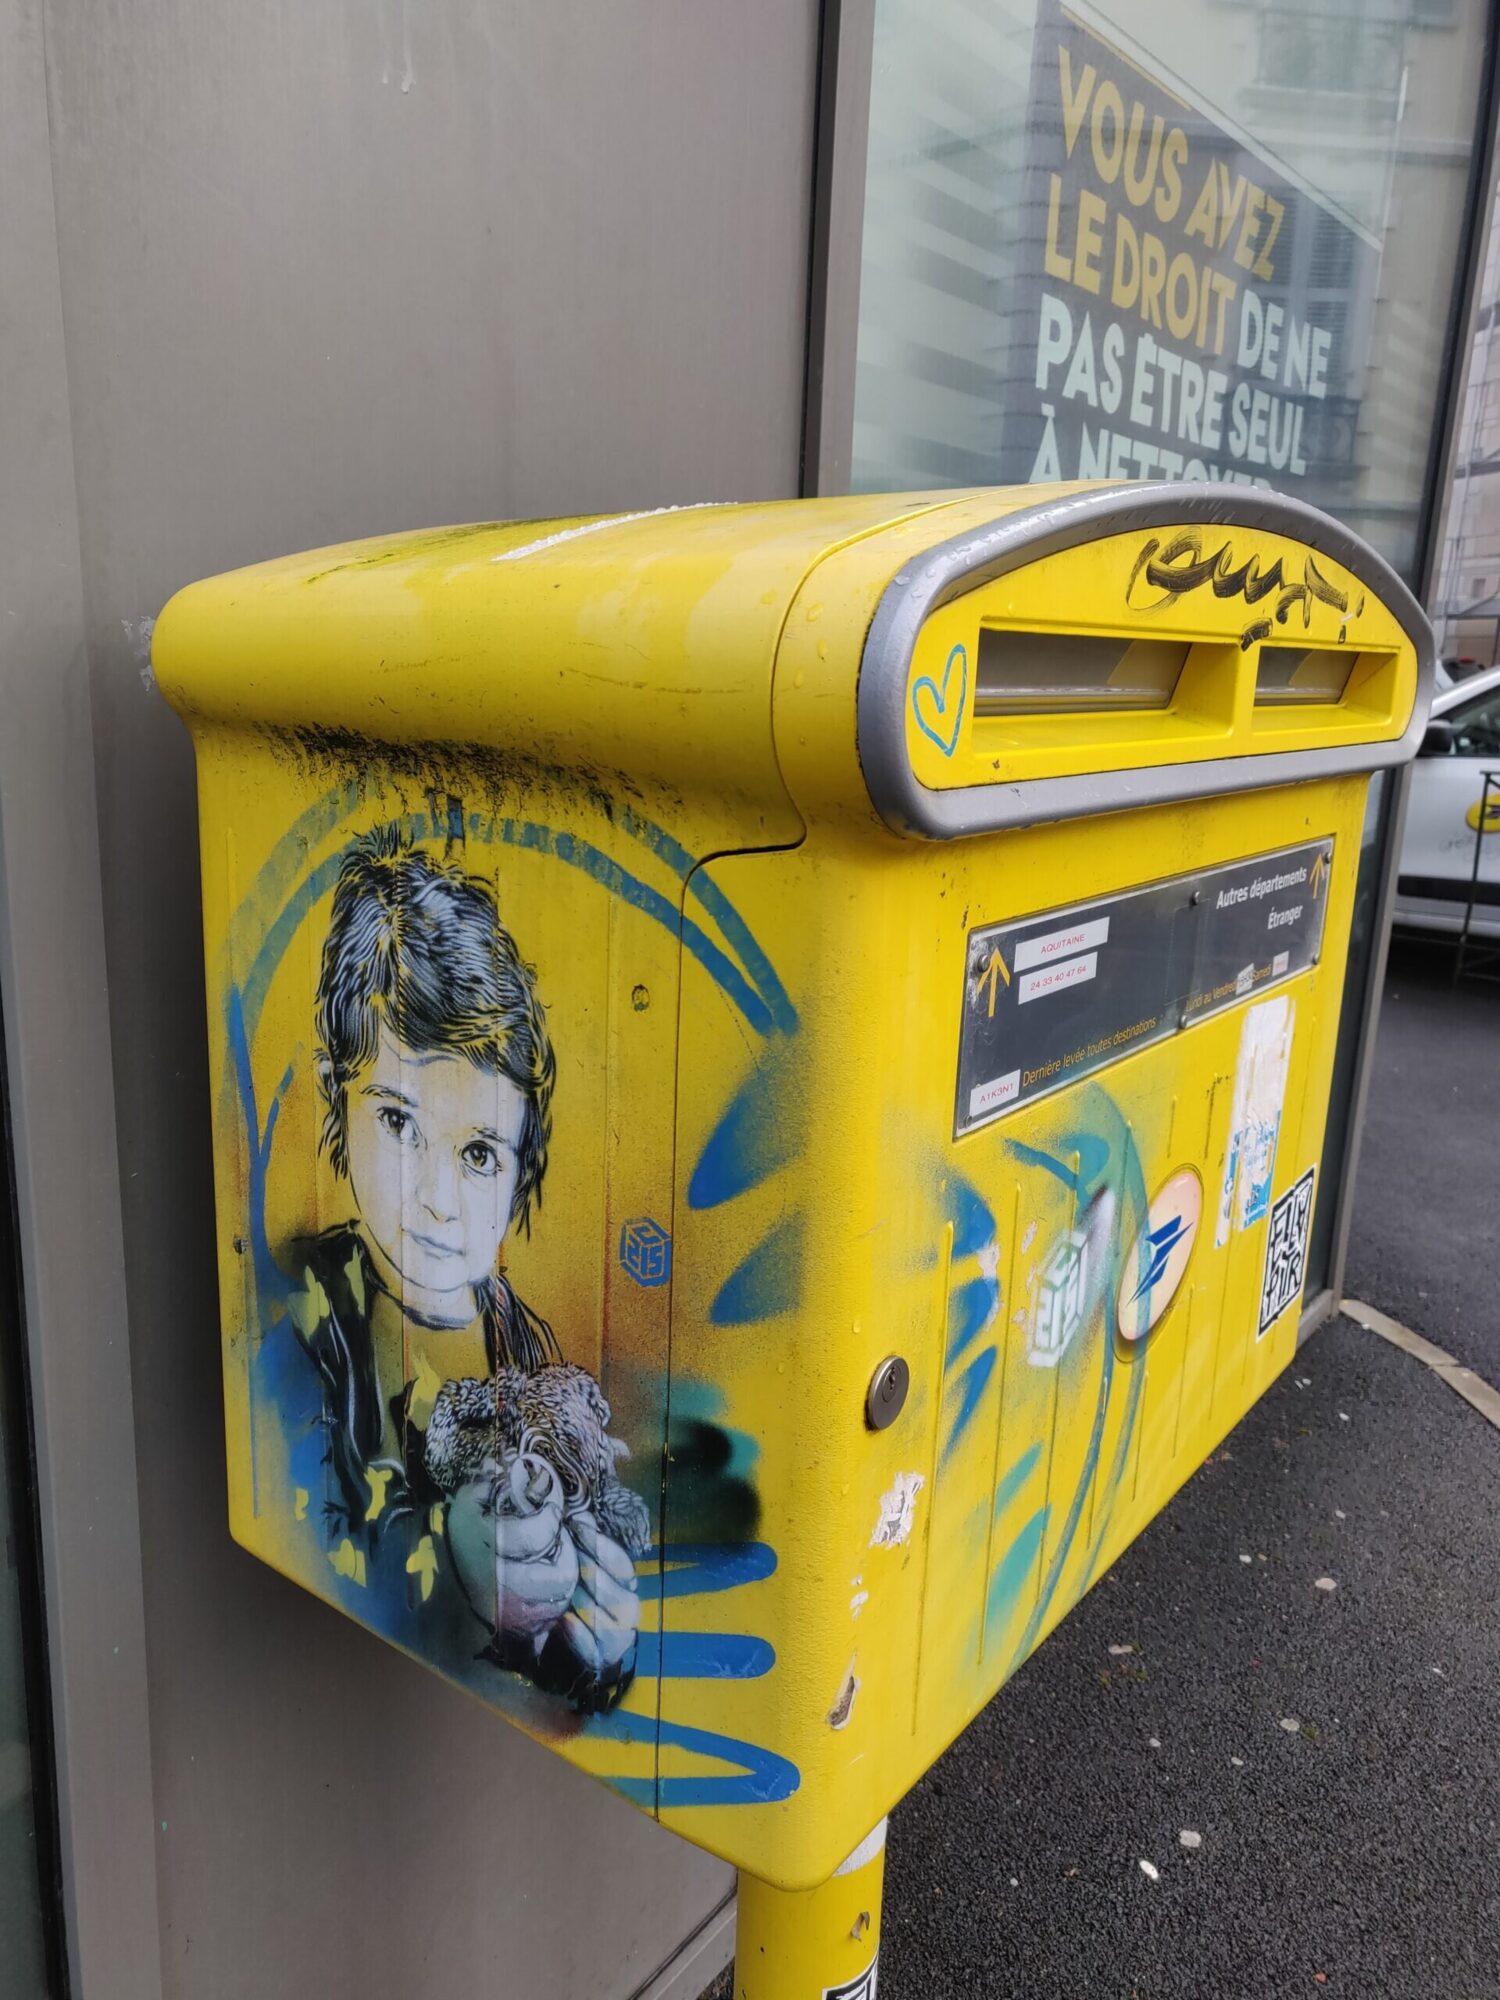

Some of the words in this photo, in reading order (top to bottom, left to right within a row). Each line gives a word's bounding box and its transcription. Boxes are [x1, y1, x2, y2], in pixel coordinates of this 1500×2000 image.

[1058, 44, 1188, 223] VOUS
[1184, 156, 1285, 281] AVEZ
[1044, 172, 1107, 296] LE
[1111, 213, 1237, 356] DROIT
[1237, 289, 1283, 380] DE
[1283, 316, 1331, 400] NE
[1035, 292, 1124, 414] PAS
[1129, 333, 1228, 451] ÊTRE
[1228, 382, 1306, 476] SEUL
[1029, 403, 1062, 484] À
[1216, 886, 1249, 910] Autres
[1249, 866, 1307, 899] départements
[1041, 933, 1085, 954] AQUITAINE
[1267, 905, 1303, 930] Étranger
[1030, 980, 1040, 992] 24
[1042, 976, 1053, 986] 33
[1054, 972, 1064, 982] 40
[1066, 968, 1075, 977] 47
[1077, 964, 1087, 974] 64
[1023, 1058, 1060, 1087] Dernière
[1063, 1047, 1086, 1068] levée
[1087, 1036, 1111, 1057] toutes
[1113, 1015, 1157, 1046] destinations
[979, 1083, 1014, 1104] A1K3N1
